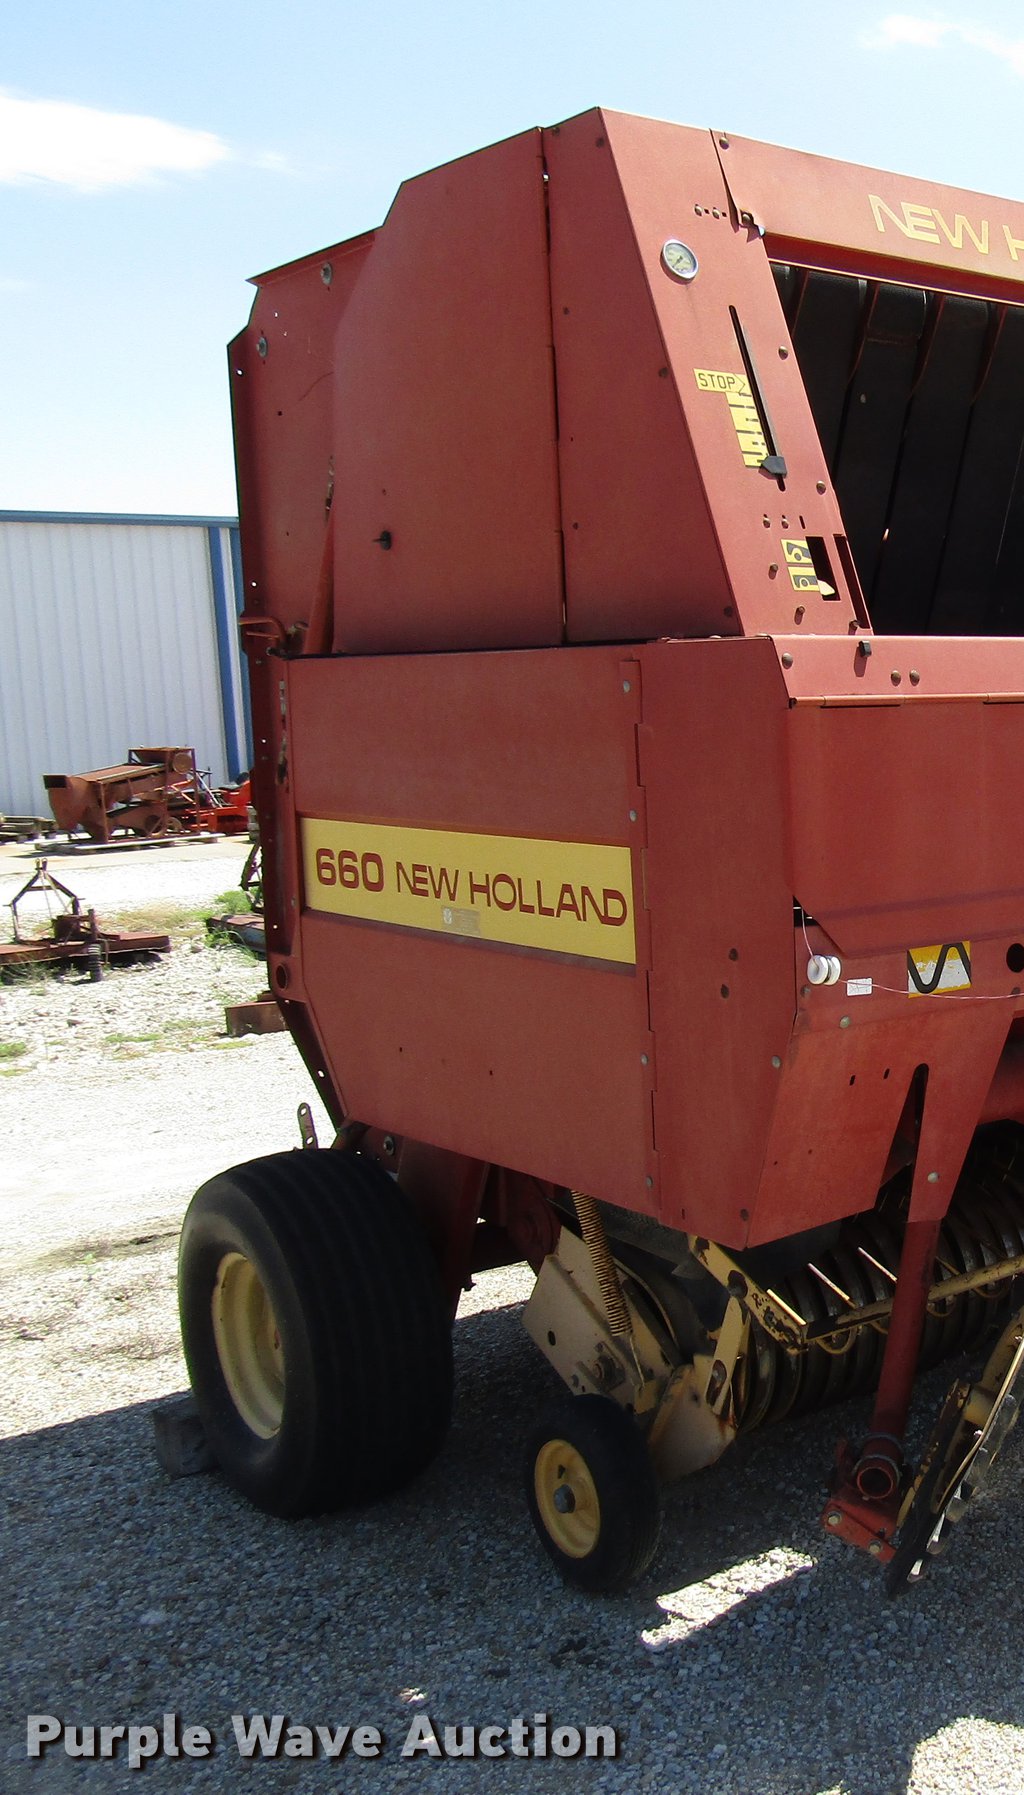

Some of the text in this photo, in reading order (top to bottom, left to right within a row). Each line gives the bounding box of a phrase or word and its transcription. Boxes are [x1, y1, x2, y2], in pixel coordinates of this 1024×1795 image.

[868, 194, 988, 255] NEW
[698, 372, 736, 390] STOP
[315, 848, 385, 893] 660
[395, 861, 460, 902] NEW
[468, 870, 628, 927] HOLLAND
